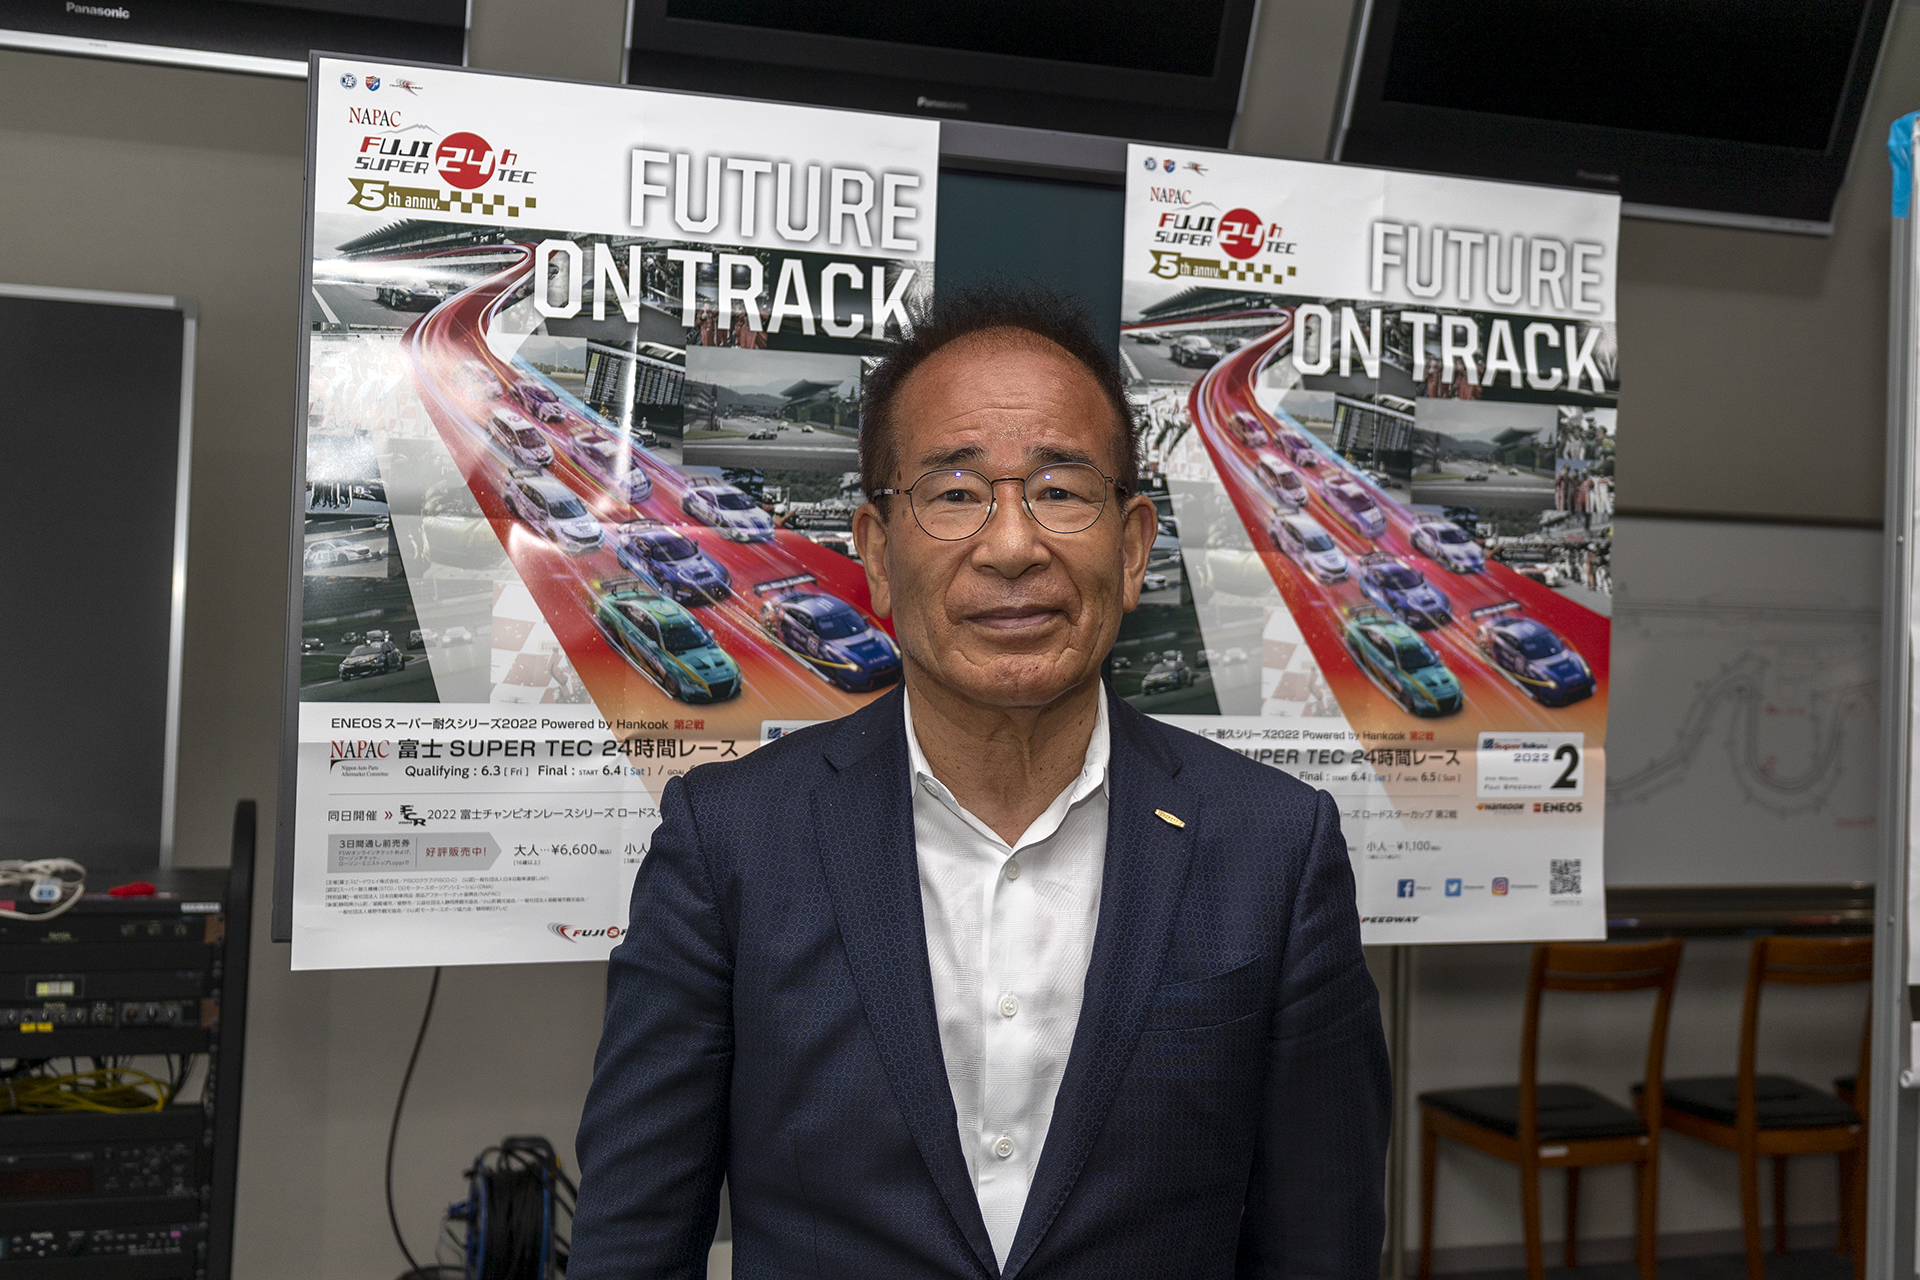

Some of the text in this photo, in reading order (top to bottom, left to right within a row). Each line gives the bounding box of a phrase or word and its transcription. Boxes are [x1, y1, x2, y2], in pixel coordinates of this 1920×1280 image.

[66, 2, 130, 20] Panasonic
[349, 107, 401, 127] NAPAC
[360, 136, 433, 158] FUJI
[354, 156, 537, 184] SUPER TEC
[405, 194, 441, 210] anniv.
[630, 149, 920, 251] FUTURE
[1150, 186, 1191, 204] NAPAC
[1158, 212, 1215, 232] FUJI
[1154, 230, 1297, 254] SUPER TEC
[1372, 222, 1603, 312] FUTURE
[534, 238, 916, 340] ON TRACK
[1292, 304, 1604, 394] ON TRACK
[541, 718, 595, 730] Powered
[598, 718, 613, 731] by
[616, 719, 669, 730] Hankook
[673, 719, 705, 730] 第2戦
[1302, 730, 1345, 740] Powered
[1348, 730, 1360, 740] by
[1363, 730, 1406, 740] Hankook
[330, 740, 390, 758] NAPAC
[398, 738, 739, 759] 富士 SUPER TEC 24時間レース
[1232, 748, 1298, 764] UPER
[1307, 749, 1344, 764] TEC
[1514, 753, 1549, 762] 2022
[405, 765, 470, 779] Qualifying
[538, 765, 567, 776] Final
[1551, 743, 1580, 788] 2
[328, 810, 377, 821] 同日開催
[428, 809, 456, 820] 2022
[618, 808, 660, 818] ロードス
[1543, 802, 1582, 812] ENEOS
